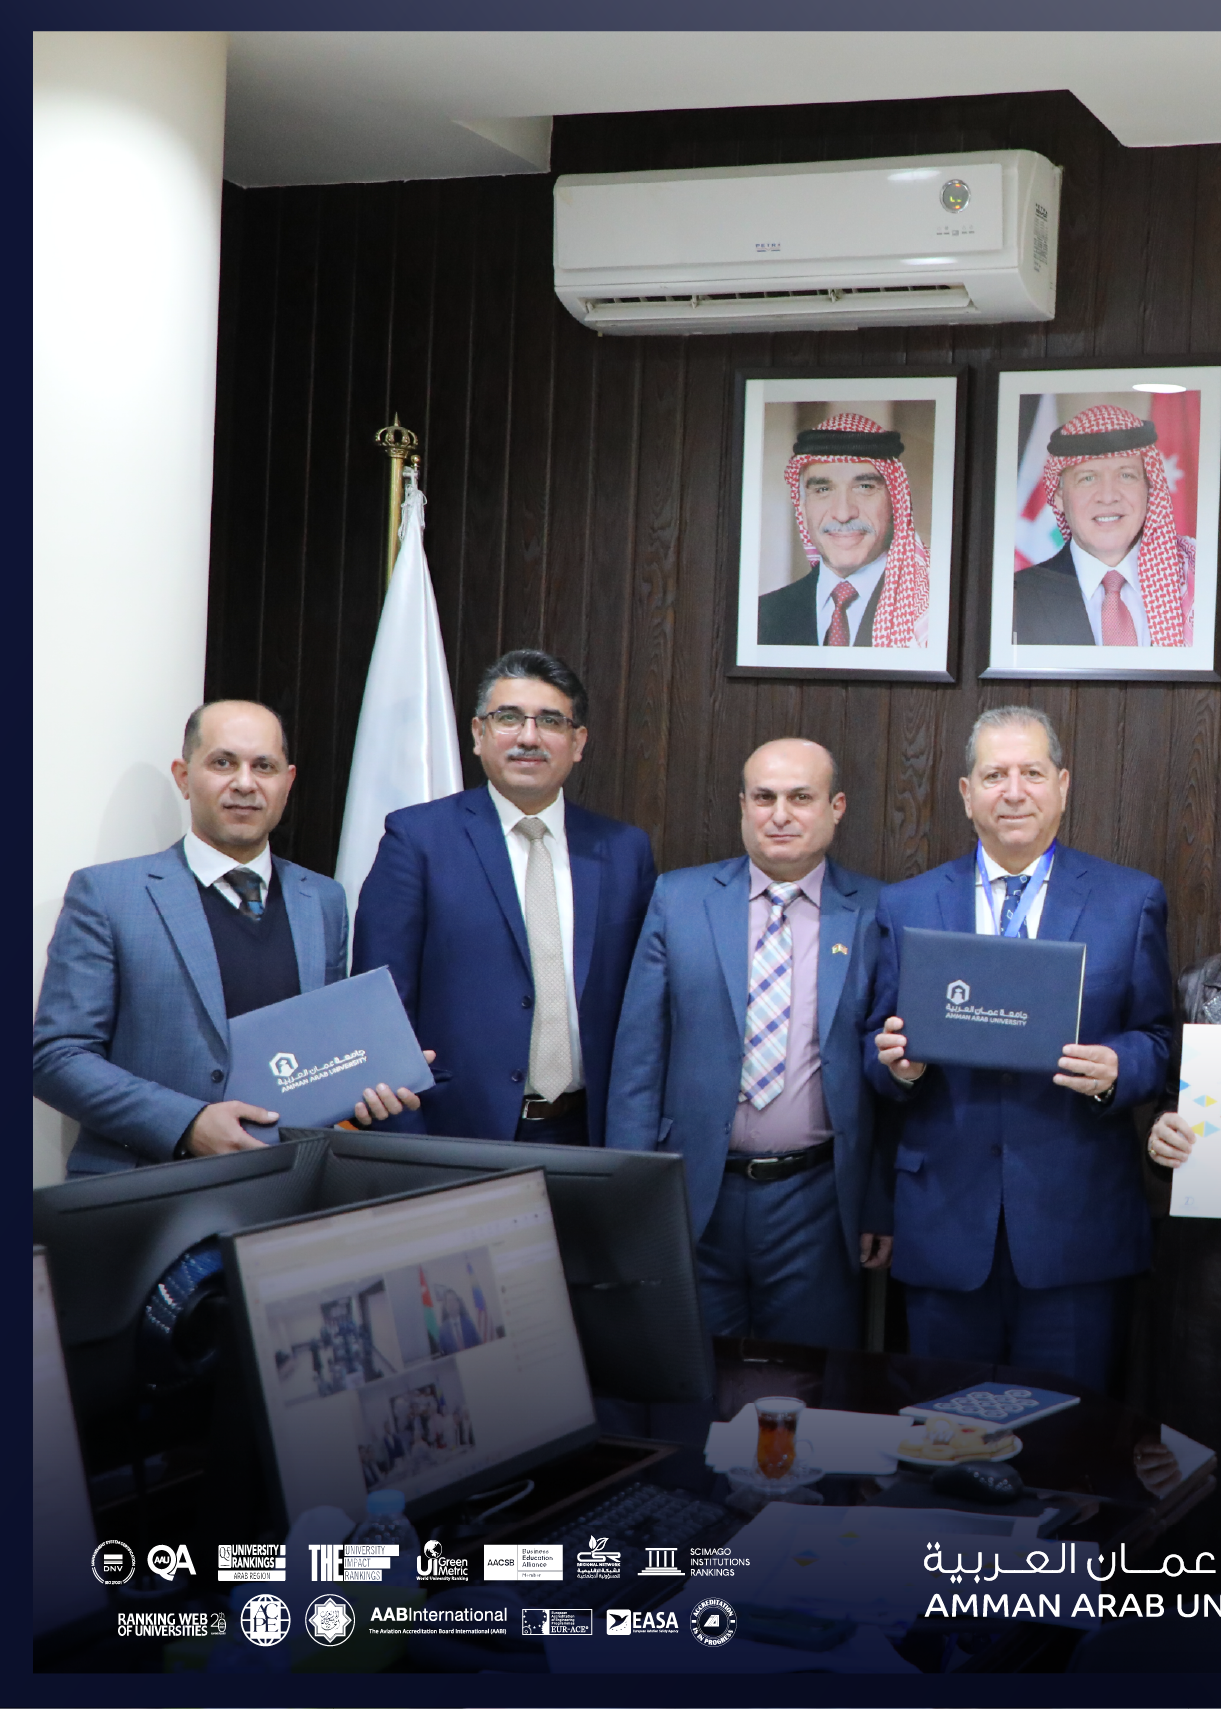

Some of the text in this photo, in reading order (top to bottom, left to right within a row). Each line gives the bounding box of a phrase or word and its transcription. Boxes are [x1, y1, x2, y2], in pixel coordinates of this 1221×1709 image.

[945, 1003, 1028, 1020] جامعة عمان العربية
[945, 1012, 1027, 1027] AMMAN ARAB UNIVERSITY
[277, 1049, 366, 1086] جامعة عمان العربية
[281, 1056, 367, 1094] AMMAN ARAB UNIVERSITY
